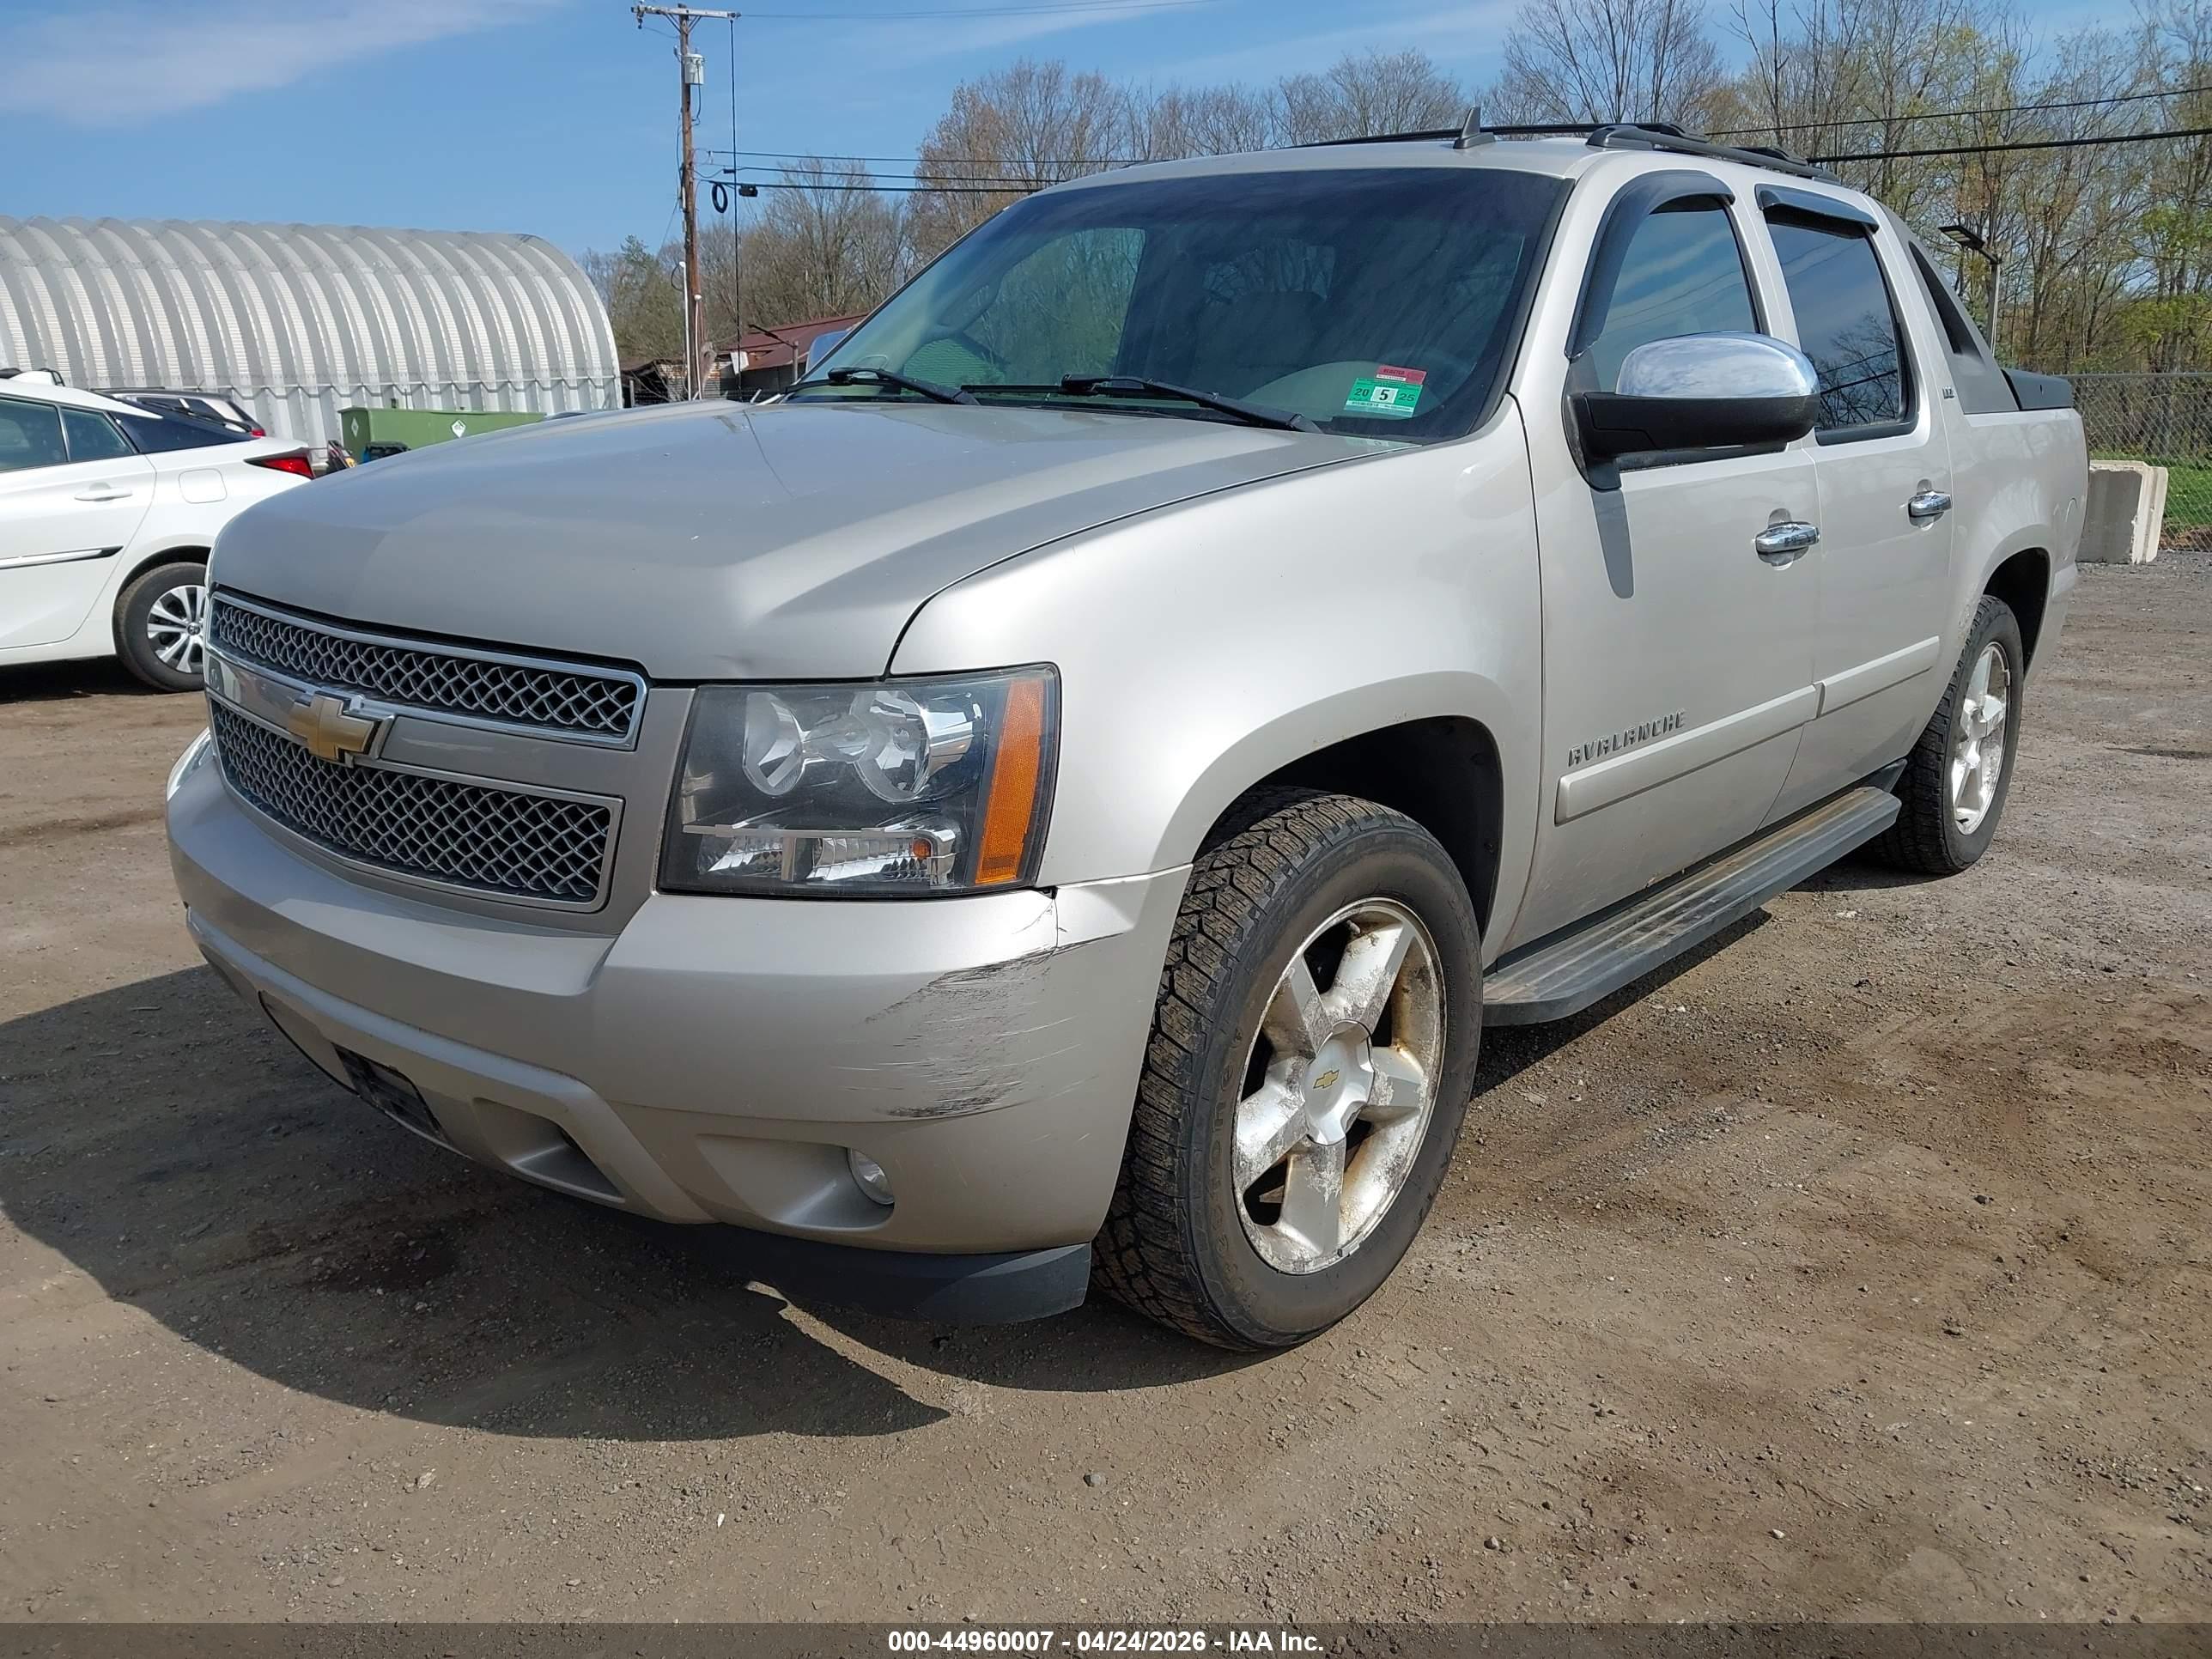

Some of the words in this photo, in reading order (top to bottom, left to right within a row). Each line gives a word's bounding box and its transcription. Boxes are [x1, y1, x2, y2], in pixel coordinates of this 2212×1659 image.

[1354, 388, 1370, 397] 20
[1379, 389, 1389, 400] 5
[1567, 708, 1686, 768] AVALANCHE
